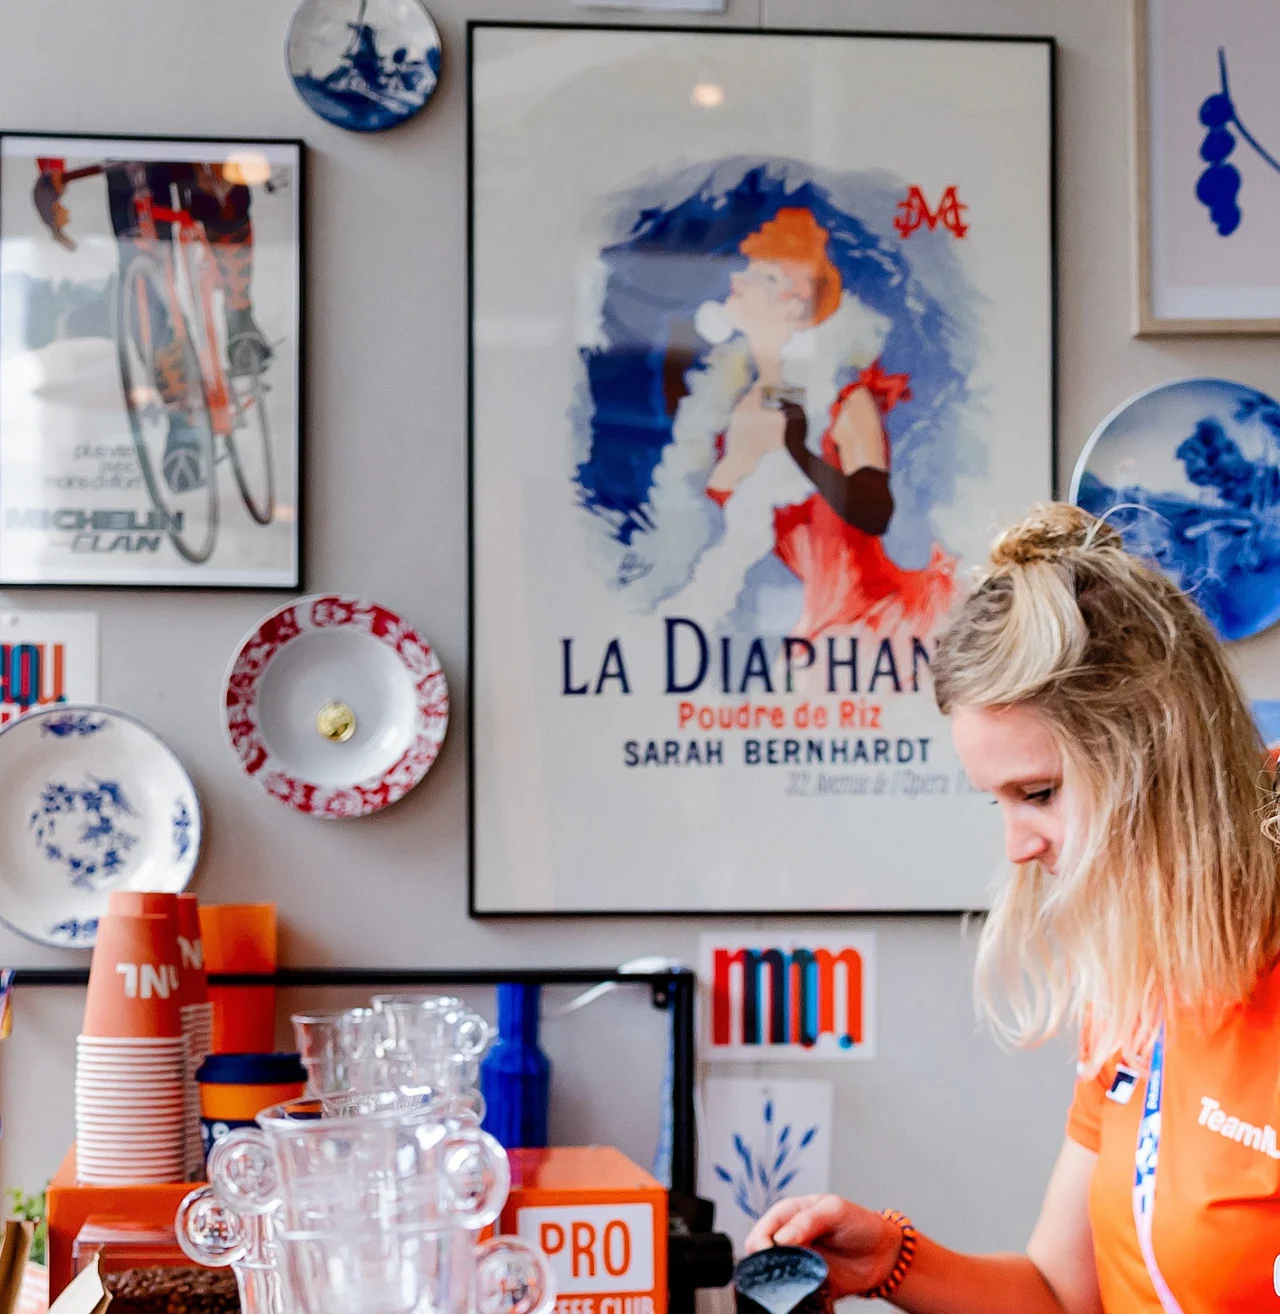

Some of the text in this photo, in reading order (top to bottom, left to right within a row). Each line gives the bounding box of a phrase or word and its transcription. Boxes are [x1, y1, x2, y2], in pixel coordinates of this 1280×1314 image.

[5, 508, 183, 532] MICHELIN
[562, 636, 633, 696] LA
[677, 698, 883, 731] Poudre de Riz
[623, 737, 933, 768] SARAH BERNHARDT
